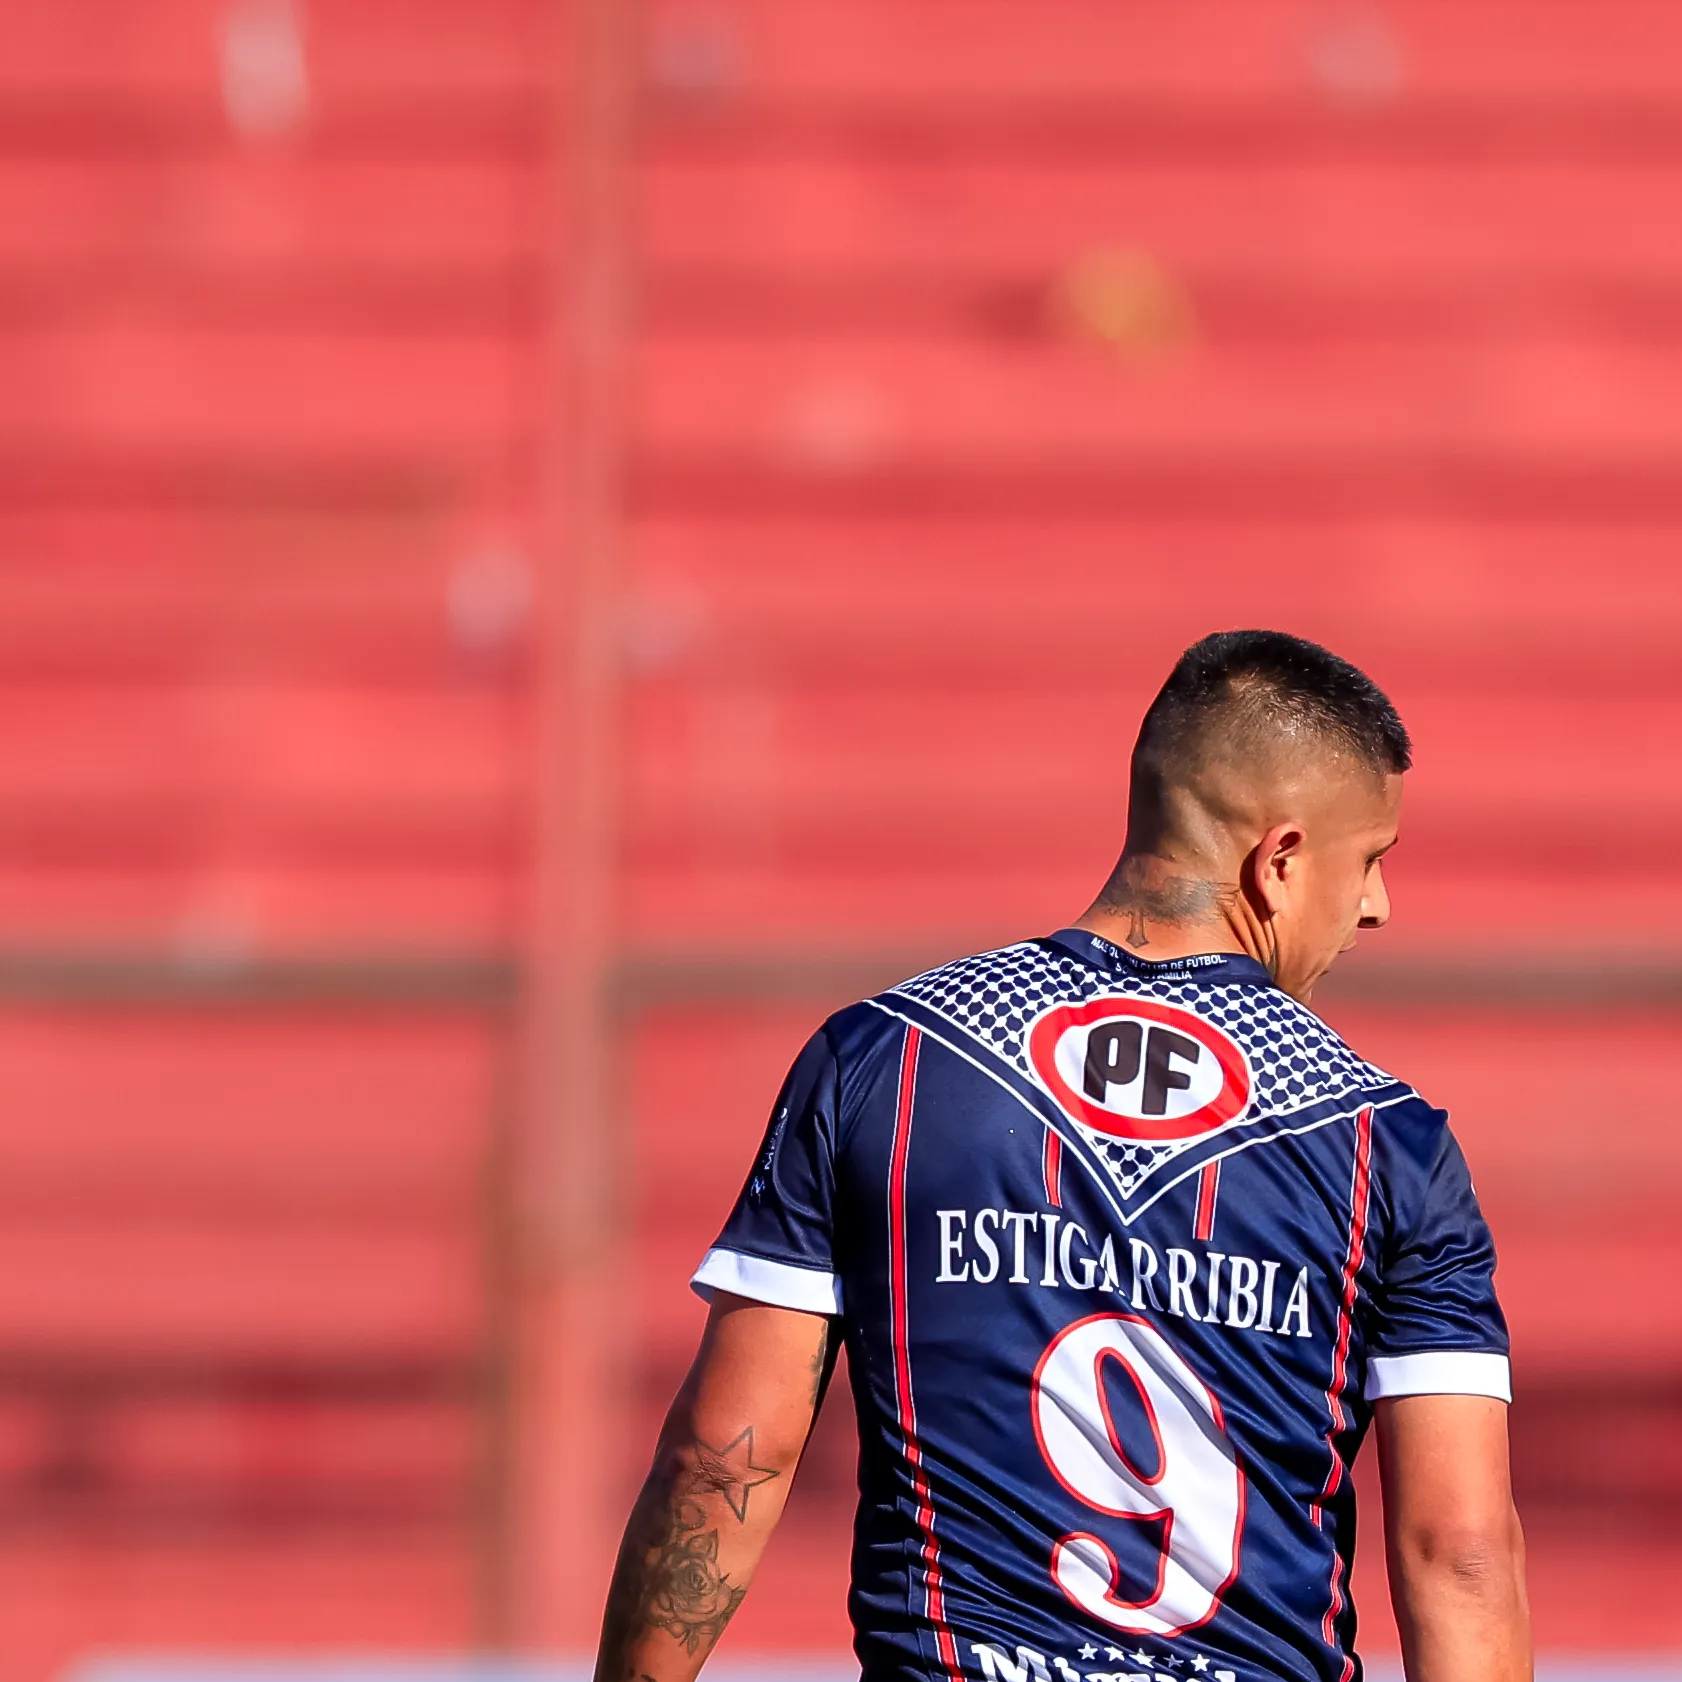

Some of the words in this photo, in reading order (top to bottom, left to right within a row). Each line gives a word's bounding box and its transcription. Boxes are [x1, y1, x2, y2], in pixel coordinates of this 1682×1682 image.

[1083, 1020, 1200, 1116] PF
[935, 1207, 1314, 1338] ESTIGARRIBIA
[1031, 1312, 1247, 1637] 9
